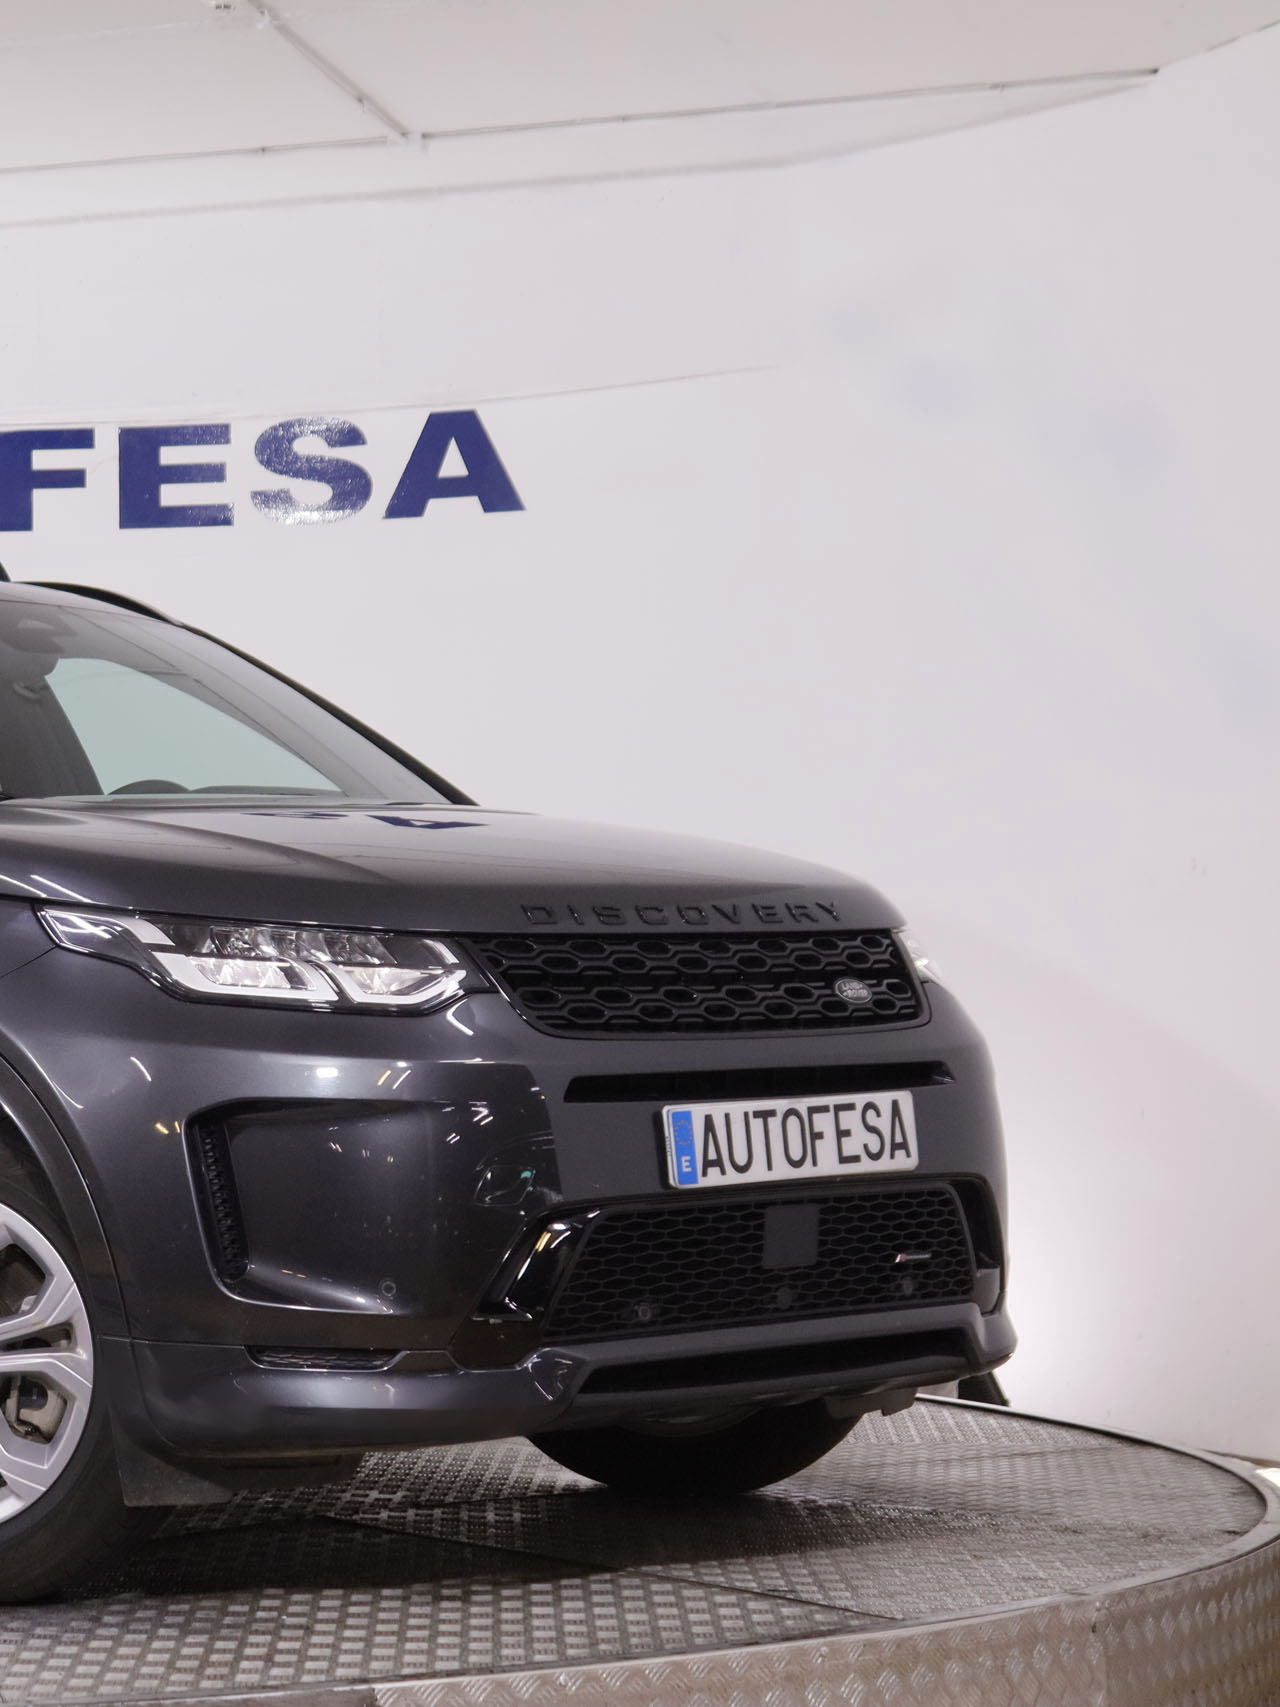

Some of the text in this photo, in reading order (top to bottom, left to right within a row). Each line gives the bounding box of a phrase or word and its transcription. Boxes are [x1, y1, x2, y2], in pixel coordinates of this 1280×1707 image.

[521, 902, 841, 926] DISCOVERY
[681, 1155, 692, 1172] E
[701, 1099, 912, 1177] AUTOFESA
